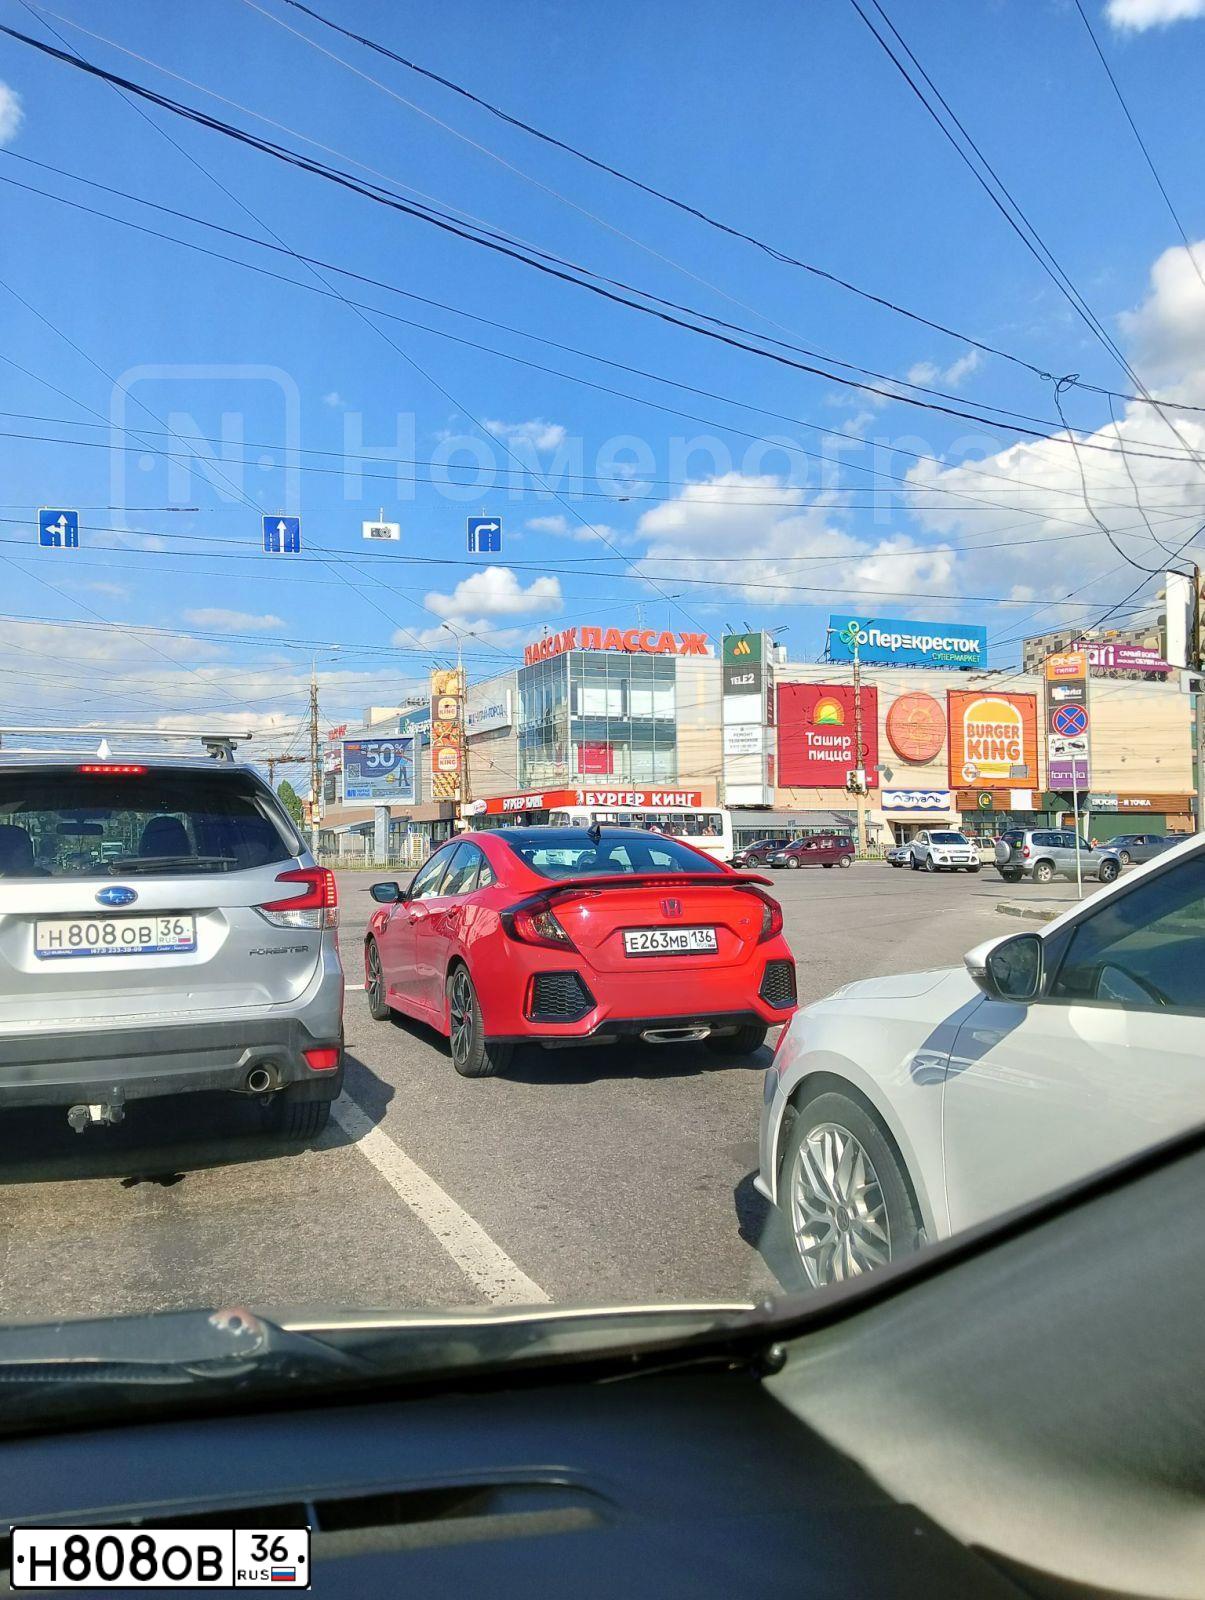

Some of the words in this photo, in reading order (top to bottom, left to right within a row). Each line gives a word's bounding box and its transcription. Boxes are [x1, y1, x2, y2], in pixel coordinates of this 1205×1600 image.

[524, 627, 577, 666] ПАССАЖ
[580, 626, 708, 654] ПАССАЖ
[868, 629, 981, 653] Перекресток
[931, 653, 980, 663] СУПЕРМАРКЕТ
[730, 673, 755, 686] TELE2
[805, 732, 851, 747] Ташир
[967, 724, 1020, 739] BURGER
[808, 749, 851, 761] пицца
[967, 740, 1021, 761] KING
[585, 792, 646, 806] БУРГЕР
[651, 793, 695, 806] КИНГ
[49, 923, 152, 948] Н808ОВ
[160, 918, 185, 936] 36
[630, 932, 689, 950] Е263МВ
[691, 931, 712, 943] 136
